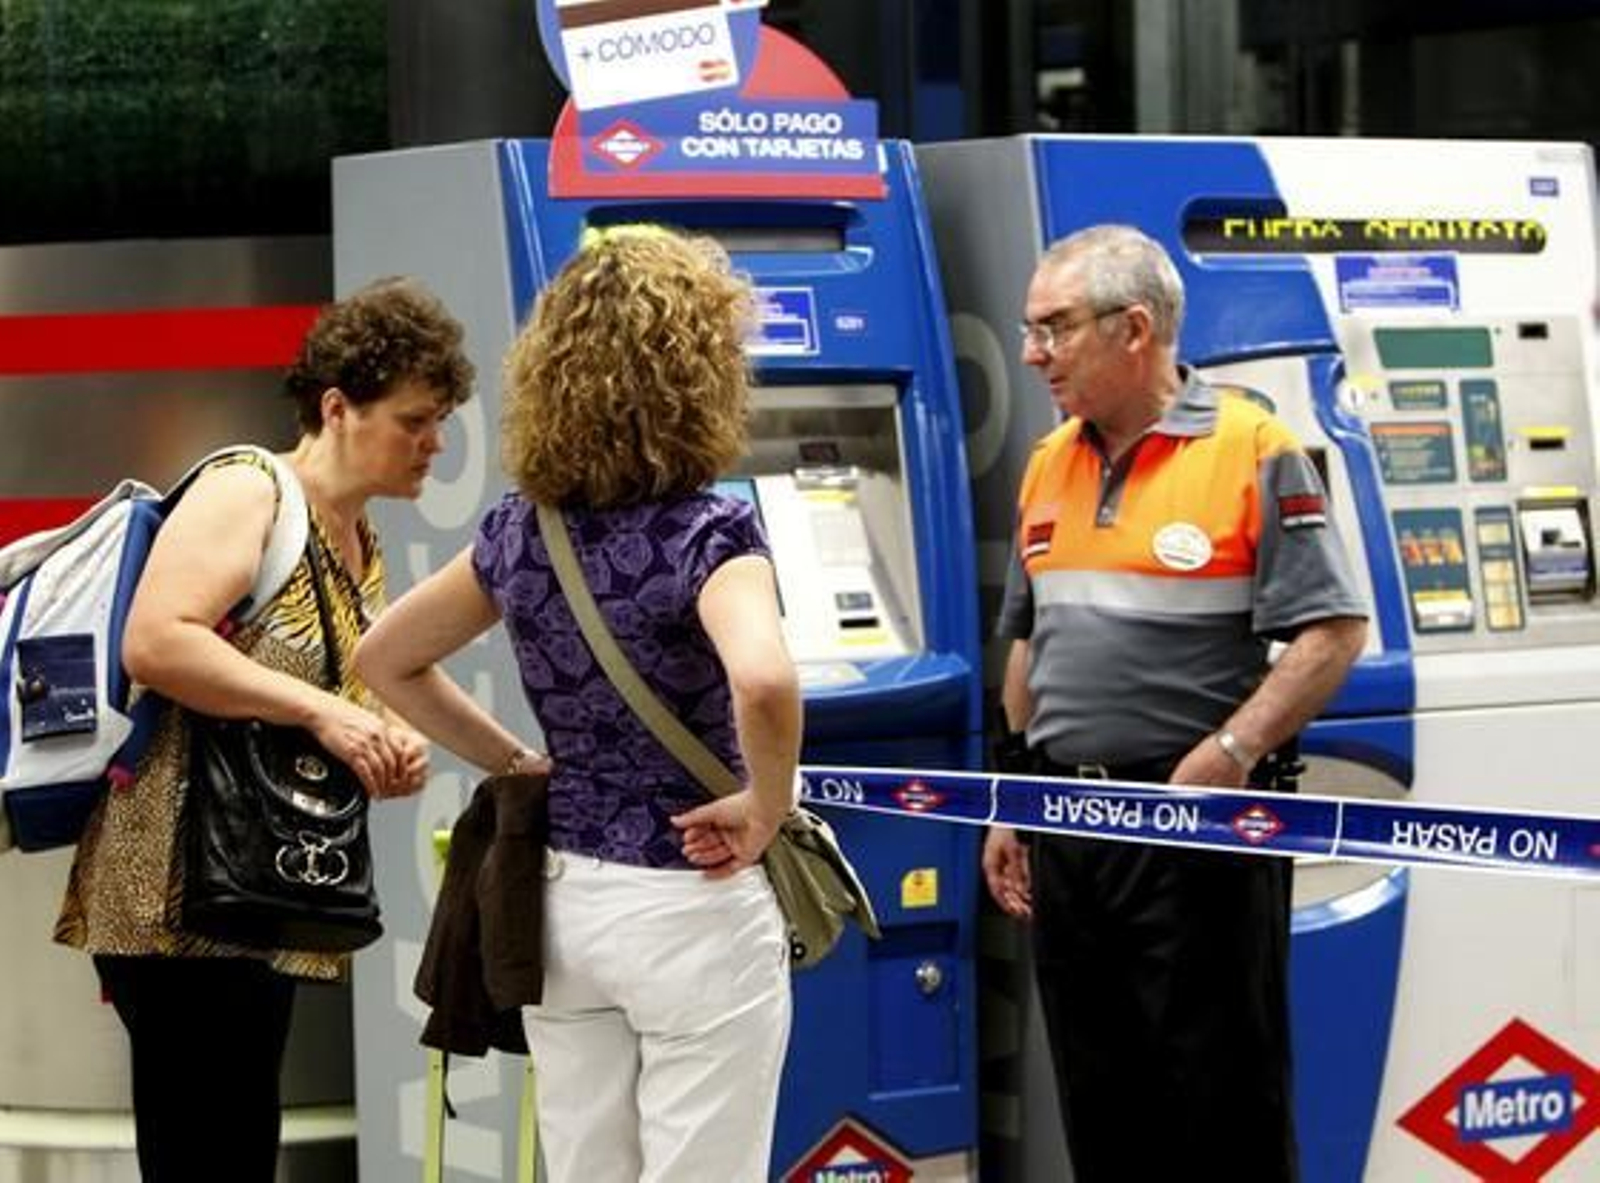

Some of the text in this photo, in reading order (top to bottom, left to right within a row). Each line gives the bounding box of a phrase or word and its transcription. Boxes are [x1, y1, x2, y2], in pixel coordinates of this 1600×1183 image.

[699, 108, 842, 134] SÓLO PAGO
[681, 136, 864, 160] CON TARJETAS
[823, 778, 863, 802] NO
[1044, 795, 1199, 832] NO PASAR
[1393, 821, 1559, 859] NO PASAR
[1464, 1089, 1565, 1130] Metro
